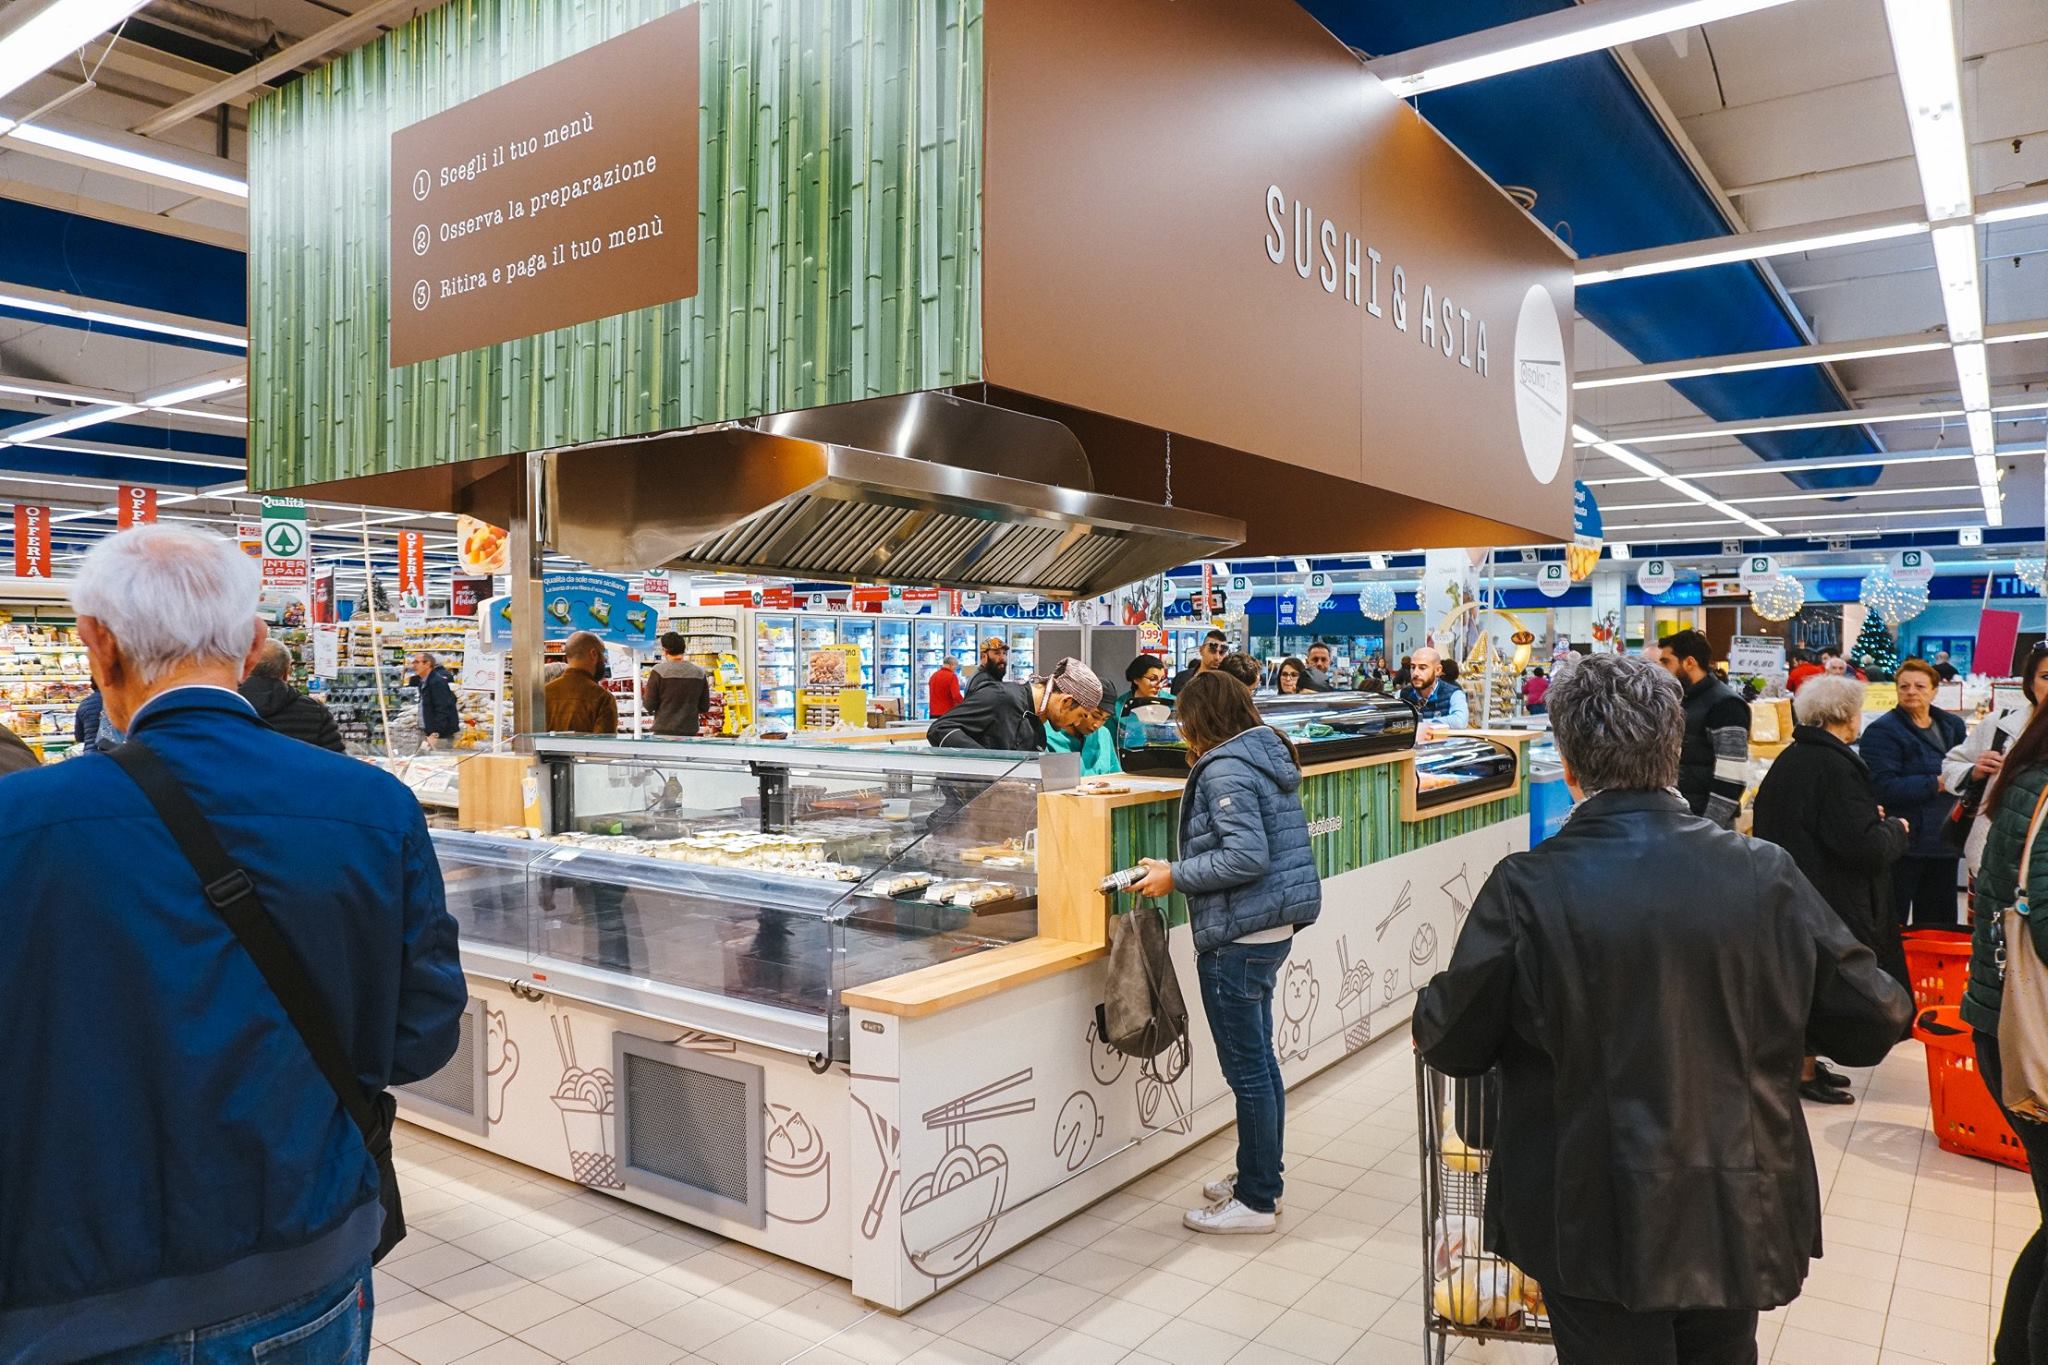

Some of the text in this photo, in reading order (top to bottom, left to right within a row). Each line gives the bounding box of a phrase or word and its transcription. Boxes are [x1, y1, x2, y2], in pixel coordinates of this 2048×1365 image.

[440, 154, 488, 188] Scegli
[492, 145, 505, 167] il
[510, 135, 538, 160] tuo
[543, 111, 595, 150] menù
[439, 209, 504, 243] Osserva
[507, 199, 524, 222] la
[529, 154, 658, 217] preparazione
[440, 270, 487, 299] Ritira
[492, 267, 501, 284] e
[506, 254, 547, 285] paga
[552, 244, 566, 265] il
[570, 234, 602, 260] tuo
[608, 214, 664, 251] menù
[1265, 184, 1488, 378] SUSHI & ASIA
[262, 495, 305, 509] Qualità
[26, 506, 41, 576] OFFERTA
[264, 568, 305, 576] SPAR
[1997, 578, 2042, 594] TIM
